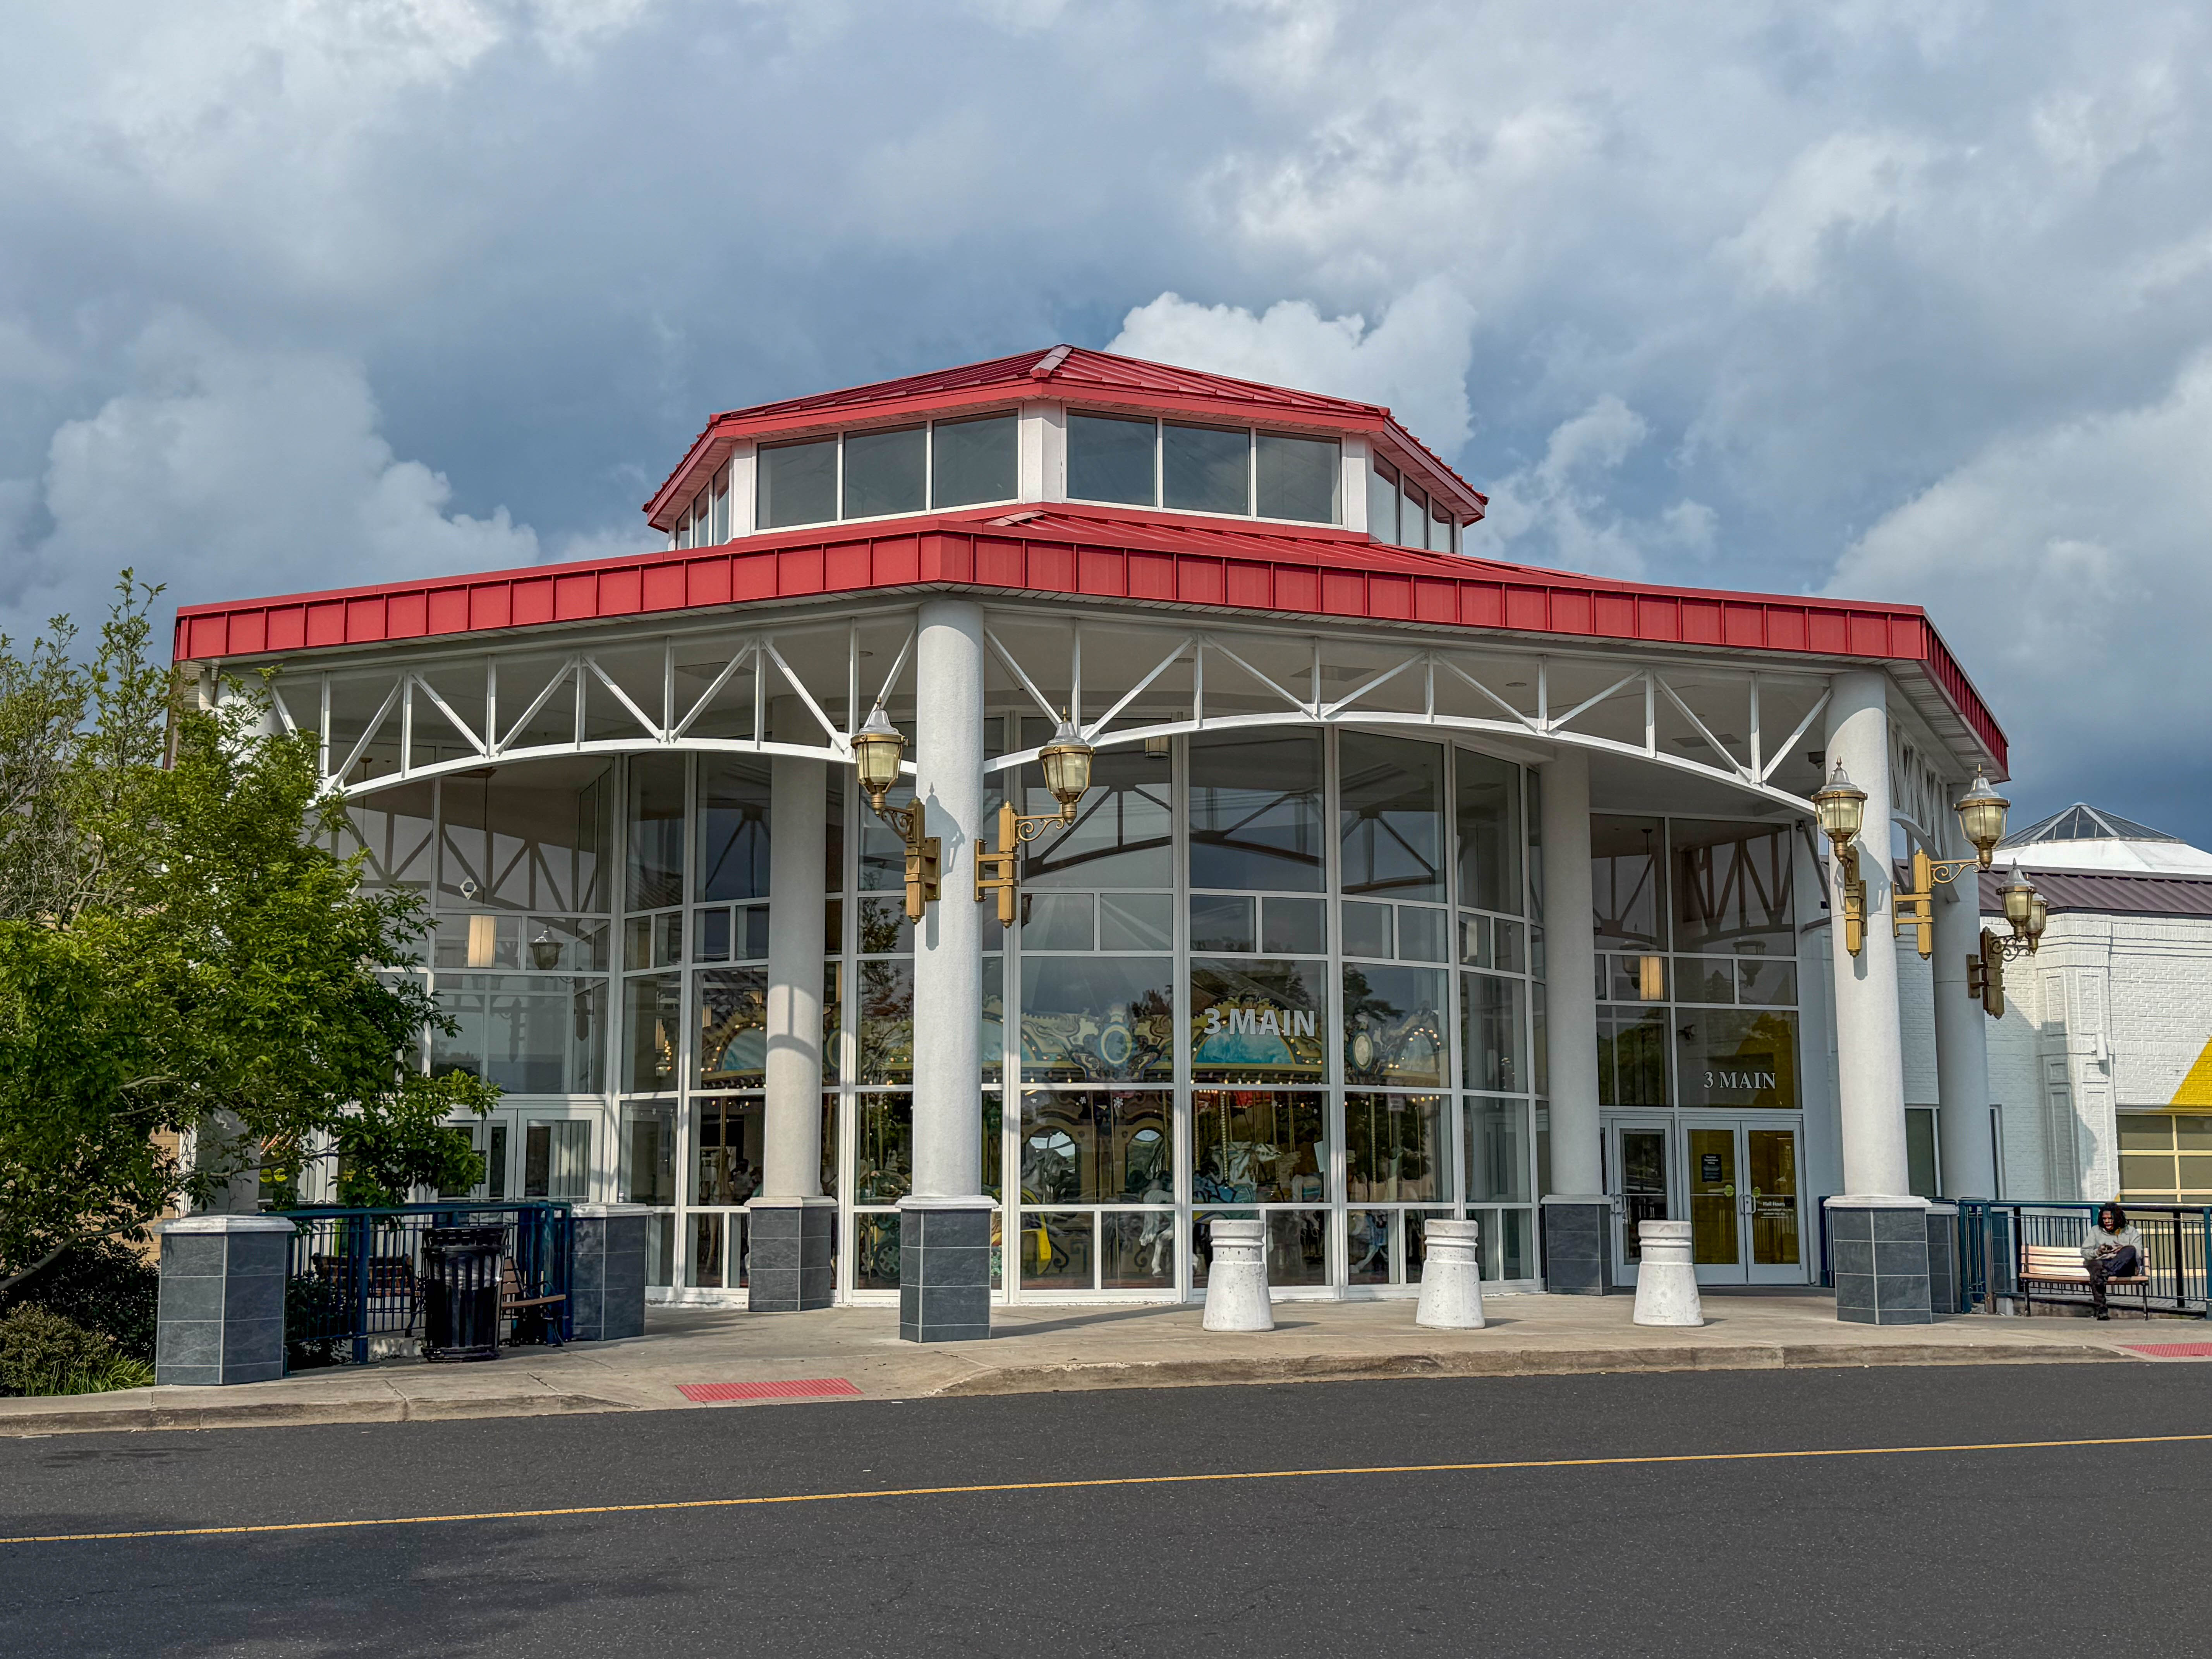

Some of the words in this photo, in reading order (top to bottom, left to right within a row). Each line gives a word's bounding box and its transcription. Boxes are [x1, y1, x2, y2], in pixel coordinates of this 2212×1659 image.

[1204, 1008, 1221, 1034] 3
[1229, 1008, 1315, 1037] MAIN
[1704, 1071, 1714, 1089] 3
[1718, 1071, 1776, 1089] MAIN
